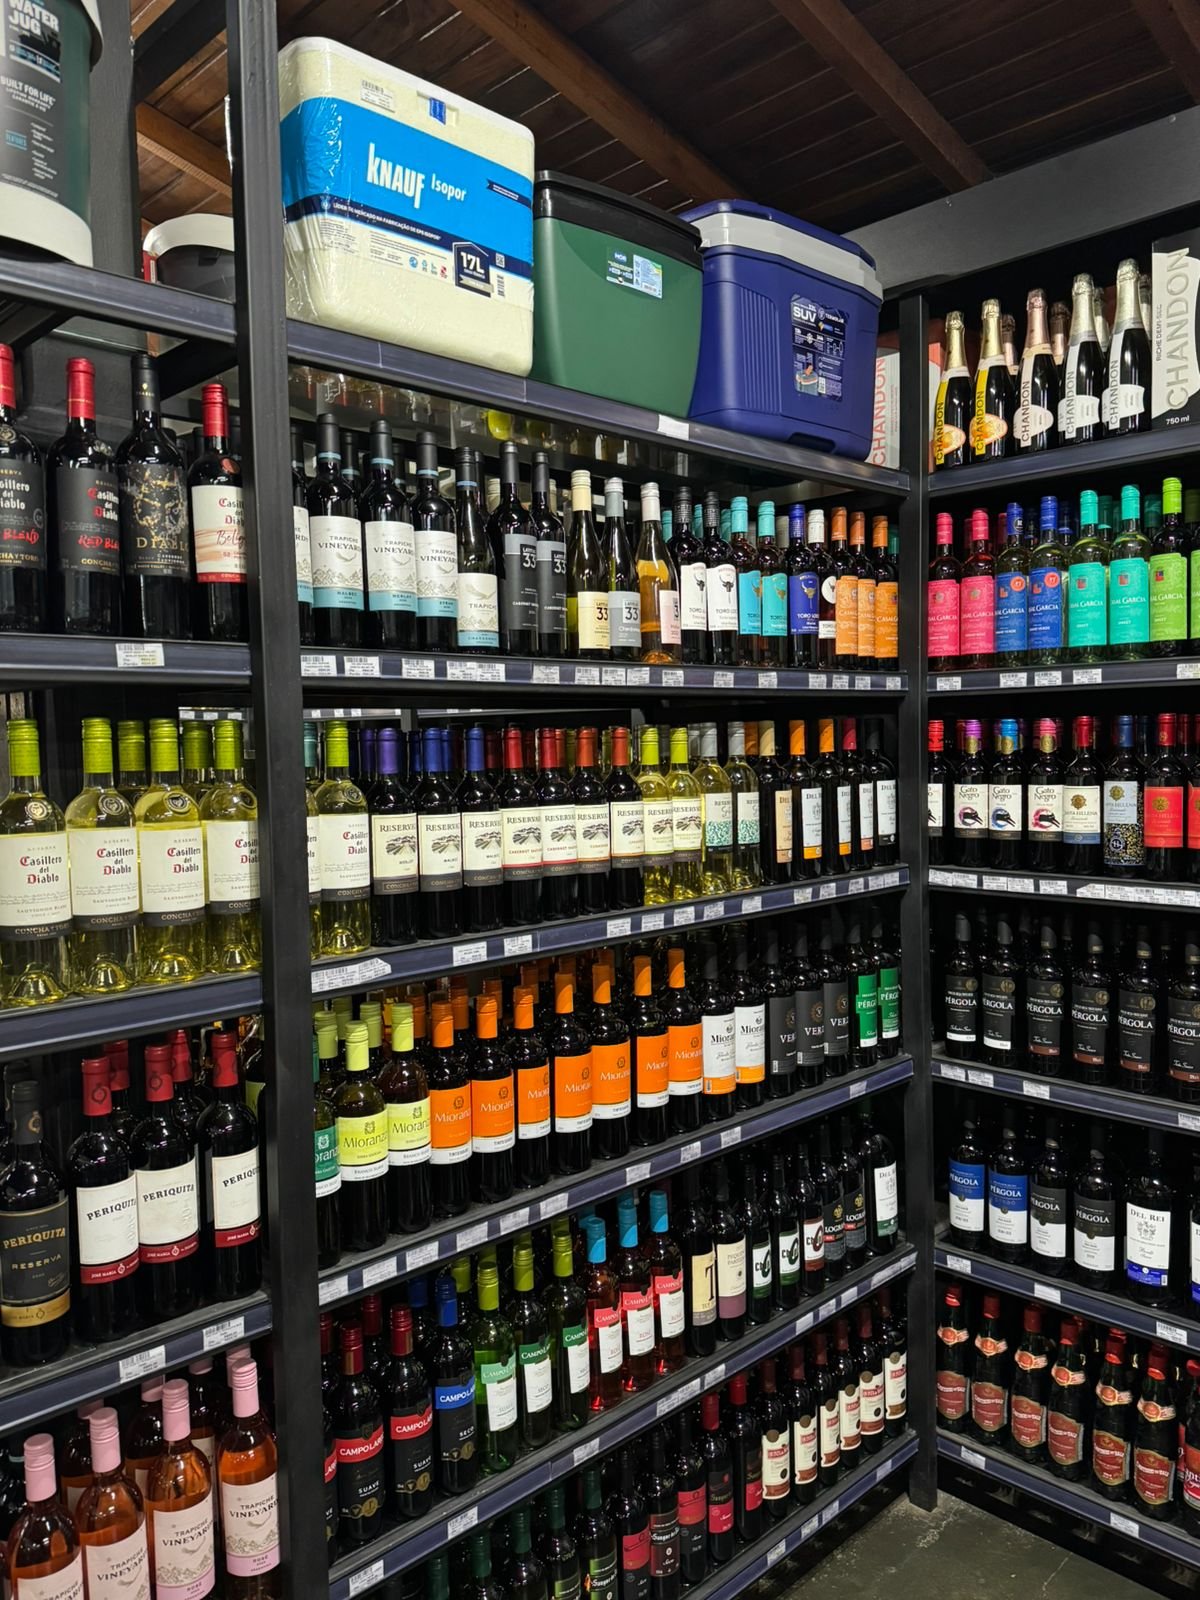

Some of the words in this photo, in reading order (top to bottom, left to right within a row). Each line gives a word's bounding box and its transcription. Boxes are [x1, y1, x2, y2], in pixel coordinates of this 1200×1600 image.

[8, 9, 41, 36] JUG
[9, 0, 60, 33] WATER
[24, 83, 39, 98] FOR
[431, 173, 467, 202] Isopor
[460, 251, 485, 275] 17L
[793, 306, 816, 323] SUV
[1166, 247, 1190, 410] CHANDON
[1108, 359, 1119, 430] CHANDON
[1065, 370, 1075, 435] CHANDON
[871, 357, 886, 468] CHANDON
[1020, 380, 1030, 443] CHANDON
[975, 390, 985, 452] CHANDON
[1166, 416, 1180, 425] 750
[1181, 415, 1190, 423] ml
[936, 401, 944, 462] CHANDON
[329, 535, 359, 544] TRAPICHE
[522, 552, 537, 569] 33
[553, 559, 567, 575] 33
[1079, 600, 1103, 608] GARCIA
[1122, 596, 1146, 604] GARCIA
[1157, 593, 1184, 601] GARCIA
[596, 607, 608, 621] 33
[624, 607, 639, 621] 33
[1035, 603, 1059, 612] GARCIA
[959, 792, 980, 801] Negro
[960, 785, 978, 794] Gato
[992, 785, 1011, 795] Gato
[1035, 786, 1055, 795] Gato
[991, 792, 1012, 802] Negro
[1033, 793, 1057, 802] Negro
[96, 847, 134, 858] Casillero
[20, 856, 62, 867] Casillero
[39, 866, 49, 874] del
[103, 865, 132, 876] Diablo
[26, 873, 60, 885] Diablo
[90, 916, 123, 924] CONCHA
[15, 925, 50, 934] CONCHA
[1130, 1208, 1147, 1220] DEL
[1149, 1214, 1165, 1222] REI
[3, 1227, 66, 1249] PERIQUITA
[12, 1253, 62, 1270] RESERVA
[459, 1426, 474, 1437] SECO
[358, 1480, 380, 1494] SUAVE
[240, 1495, 275, 1510] TRAPICHE
[175, 1518, 209, 1537] TRAPICHE
[110, 1547, 144, 1571] TRAPICHE
